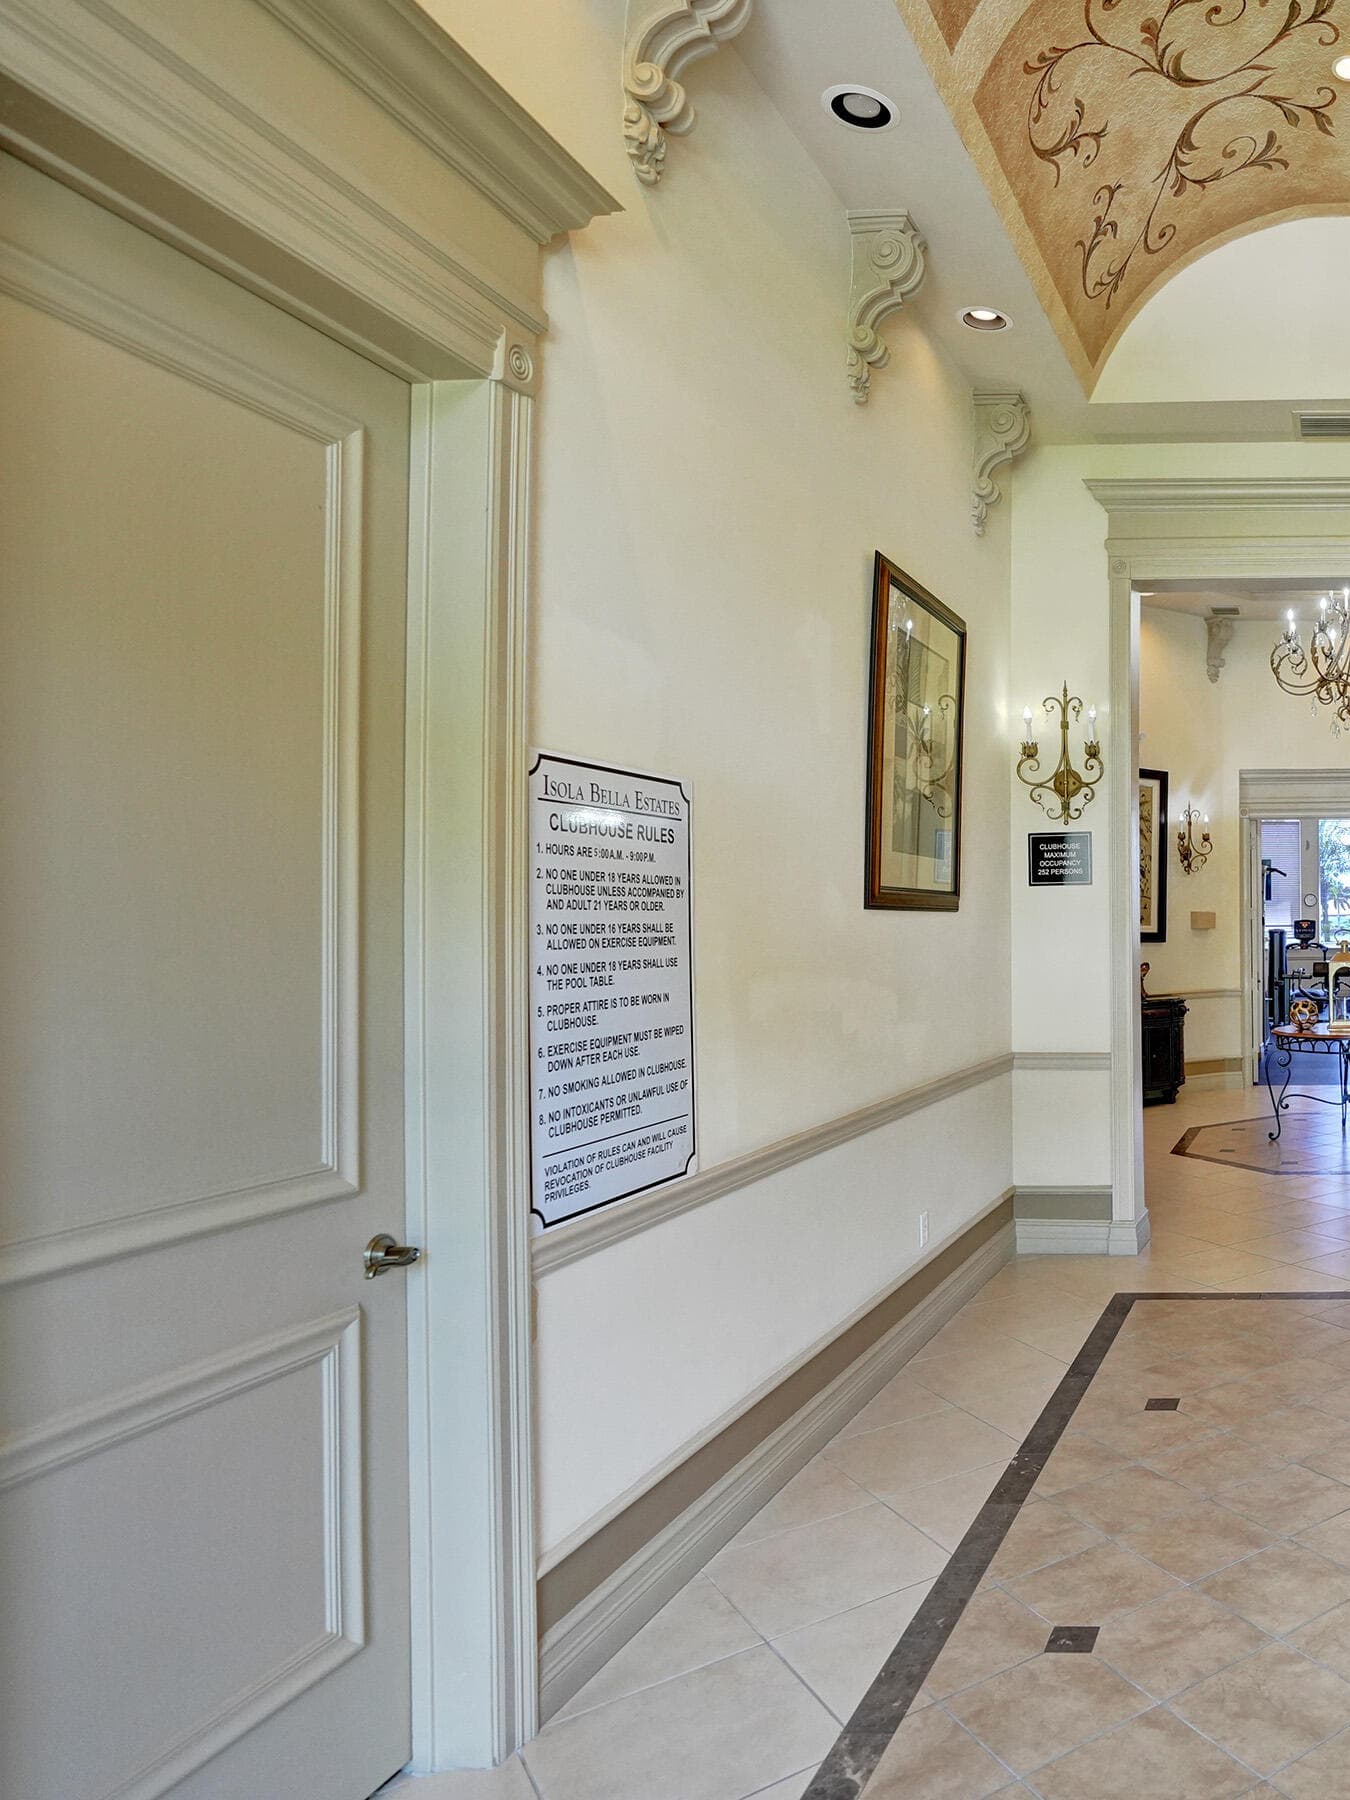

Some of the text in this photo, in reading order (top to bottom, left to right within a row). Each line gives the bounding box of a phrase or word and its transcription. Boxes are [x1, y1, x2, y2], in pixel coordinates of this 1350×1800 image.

[543, 775, 680, 816] ISOLA BELLA ESTATES
[549, 813, 674, 844] CLUBHOUSE RULES
[536, 842, 543, 854] 1.
[546, 843, 575, 856] HOURS
[577, 846, 592, 858] ARE
[536, 868, 681, 886] 2. NO ONE UNDER 18 YEARS ALLOWED IN
[546, 883, 685, 898] CLUBHOUSE UNLESS ACCOMPANIED BY
[546, 899, 665, 911] AND ADULT 21 YEARS OR OLDER.
[536, 923, 673, 935] 3. NO ONE UNDER 16 YEARS SHALL BE
[546, 936, 677, 950] ALLOWED ON EXERCISE EQUIPMENT.
[537, 957, 678, 976] 4. NO ONE UNDER 18 YEARS SHALL USE
[547, 975, 615, 991] THE POOL TABLE.
[537, 992, 670, 1018] 5. PROPER ATTIRE IS TO BE WORN IN
[547, 1015, 599, 1032] CLUBHOUSE.
[538, 1024, 684, 1059] 6. EXERCISE EQUIPMENT MUST BE WIPED
[547, 1046, 640, 1072] DOWN AFTER EACH USE.
[538, 1058, 687, 1099] 7. NO SMOKING ALLOWED IN CLUBHOUSE.
[539, 1079, 688, 1125] 8. NO INTOXICANTS OR UNLAWFUL USE OF
[548, 1104, 642, 1138] CLUBHOUSE PERMITTED.
[544, 1124, 687, 1176] VIOLATION OF RULES CAN AND WILL CAUSE
[544, 1140, 673, 1191] REVOCATION OF CLUBHOUSE FACILITY
[544, 1180, 591, 1204] PRIVILEGES.
